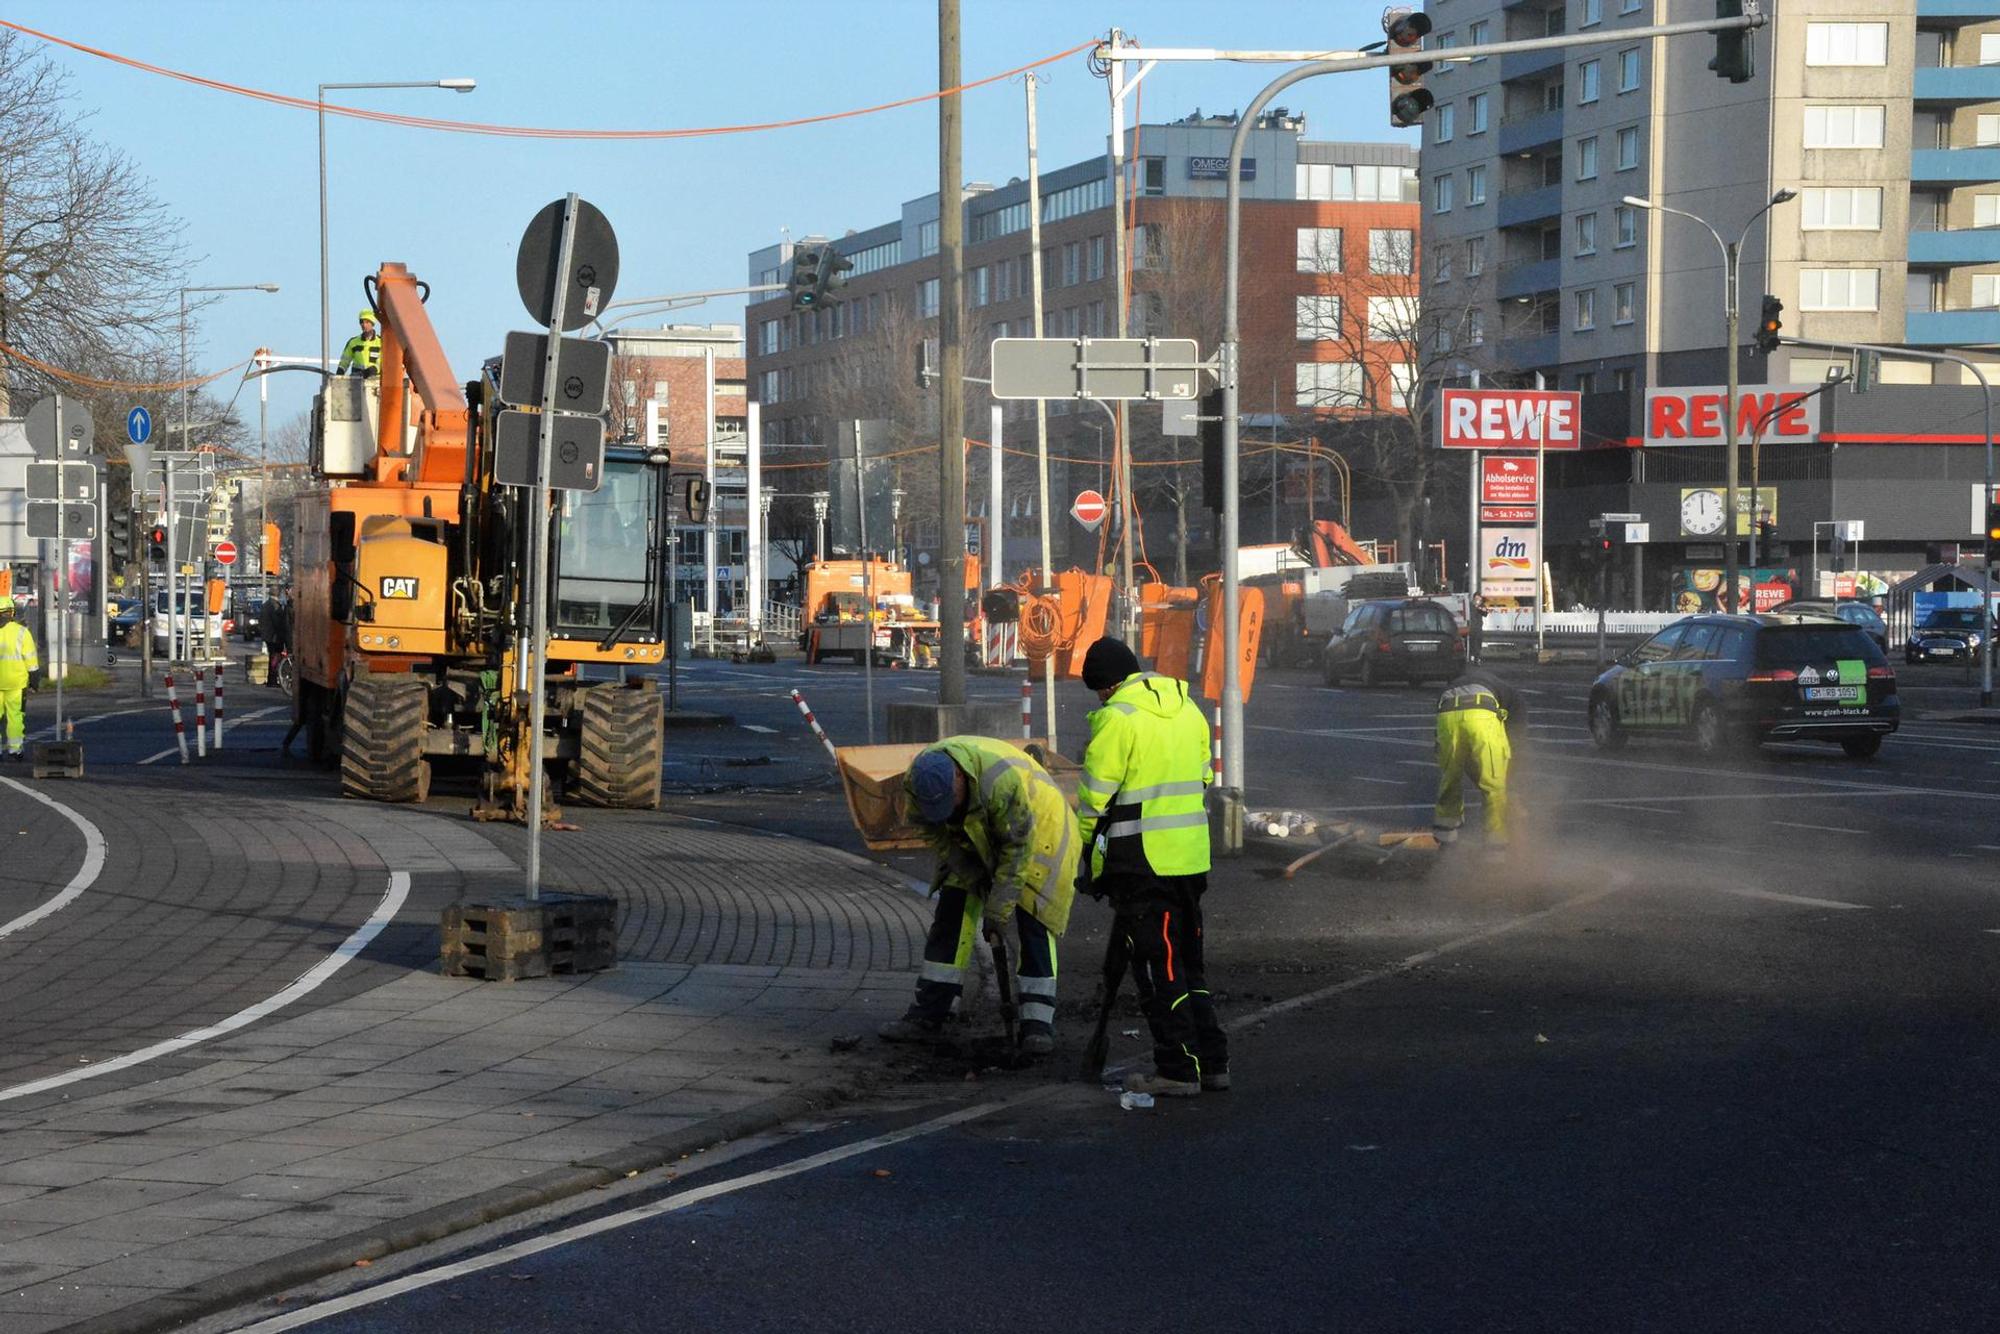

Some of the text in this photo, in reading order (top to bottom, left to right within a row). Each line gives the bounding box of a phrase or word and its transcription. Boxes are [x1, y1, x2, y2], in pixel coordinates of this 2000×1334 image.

[1449, 397, 1573, 441] REWE
[1649, 391, 1810, 439] REWE
[1485, 473, 1535, 483] Abholservice
[1496, 536, 1526, 557] dm
[383, 578, 415, 598] CAT
[1755, 589, 1785, 598] REWE
[1245, 611, 1257, 662] AVS
[1799, 676, 1820, 684] GIZEH
[1804, 708, 1870, 717] www.gizeh-black.de
